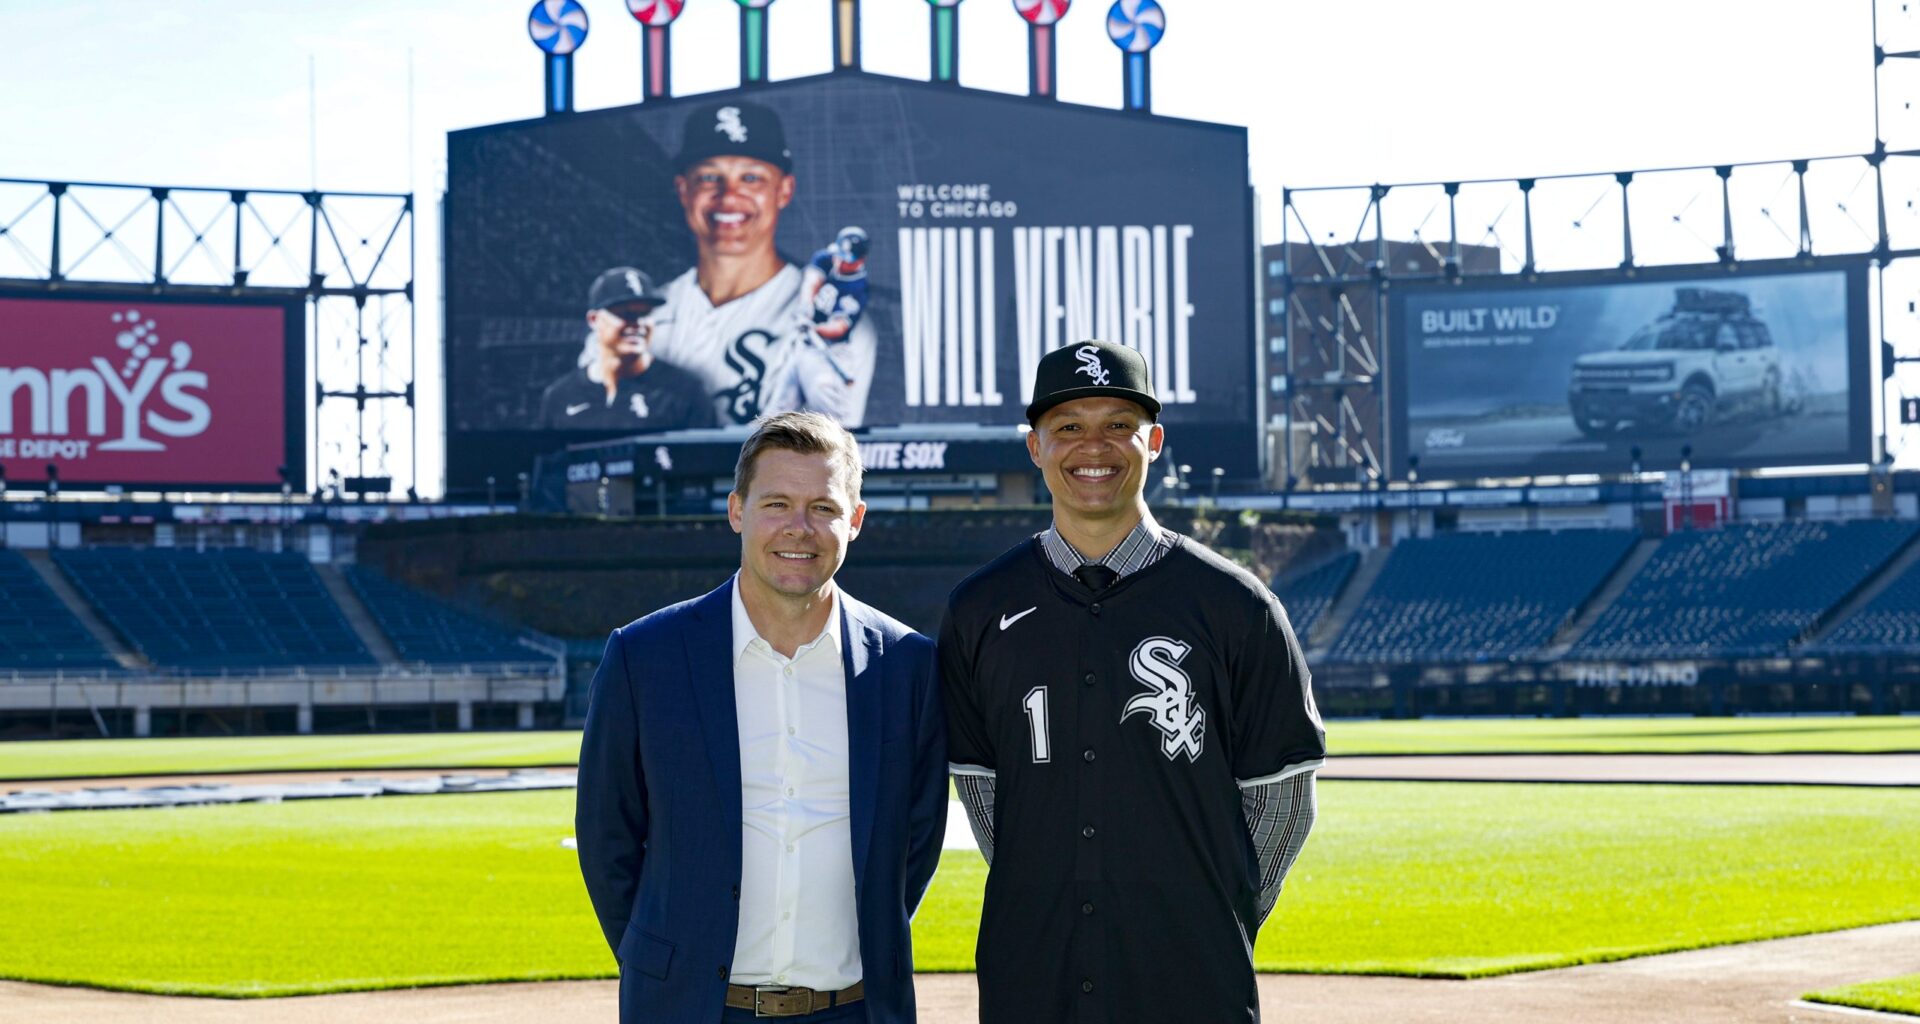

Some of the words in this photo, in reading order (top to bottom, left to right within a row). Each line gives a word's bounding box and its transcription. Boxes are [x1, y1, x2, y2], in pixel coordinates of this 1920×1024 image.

[897, 183, 991, 201] WELCOME
[897, 200, 924, 218] TO
[929, 200, 1018, 218] CHICAGO
[898, 226, 1003, 407] WILL
[1012, 224, 1197, 406] VENABLE
[1421, 308, 1489, 334] BUILT
[19, 439, 91, 460] DEPOT
[902, 441, 948, 470] SOX
[1022, 685, 1051, 764] 1
